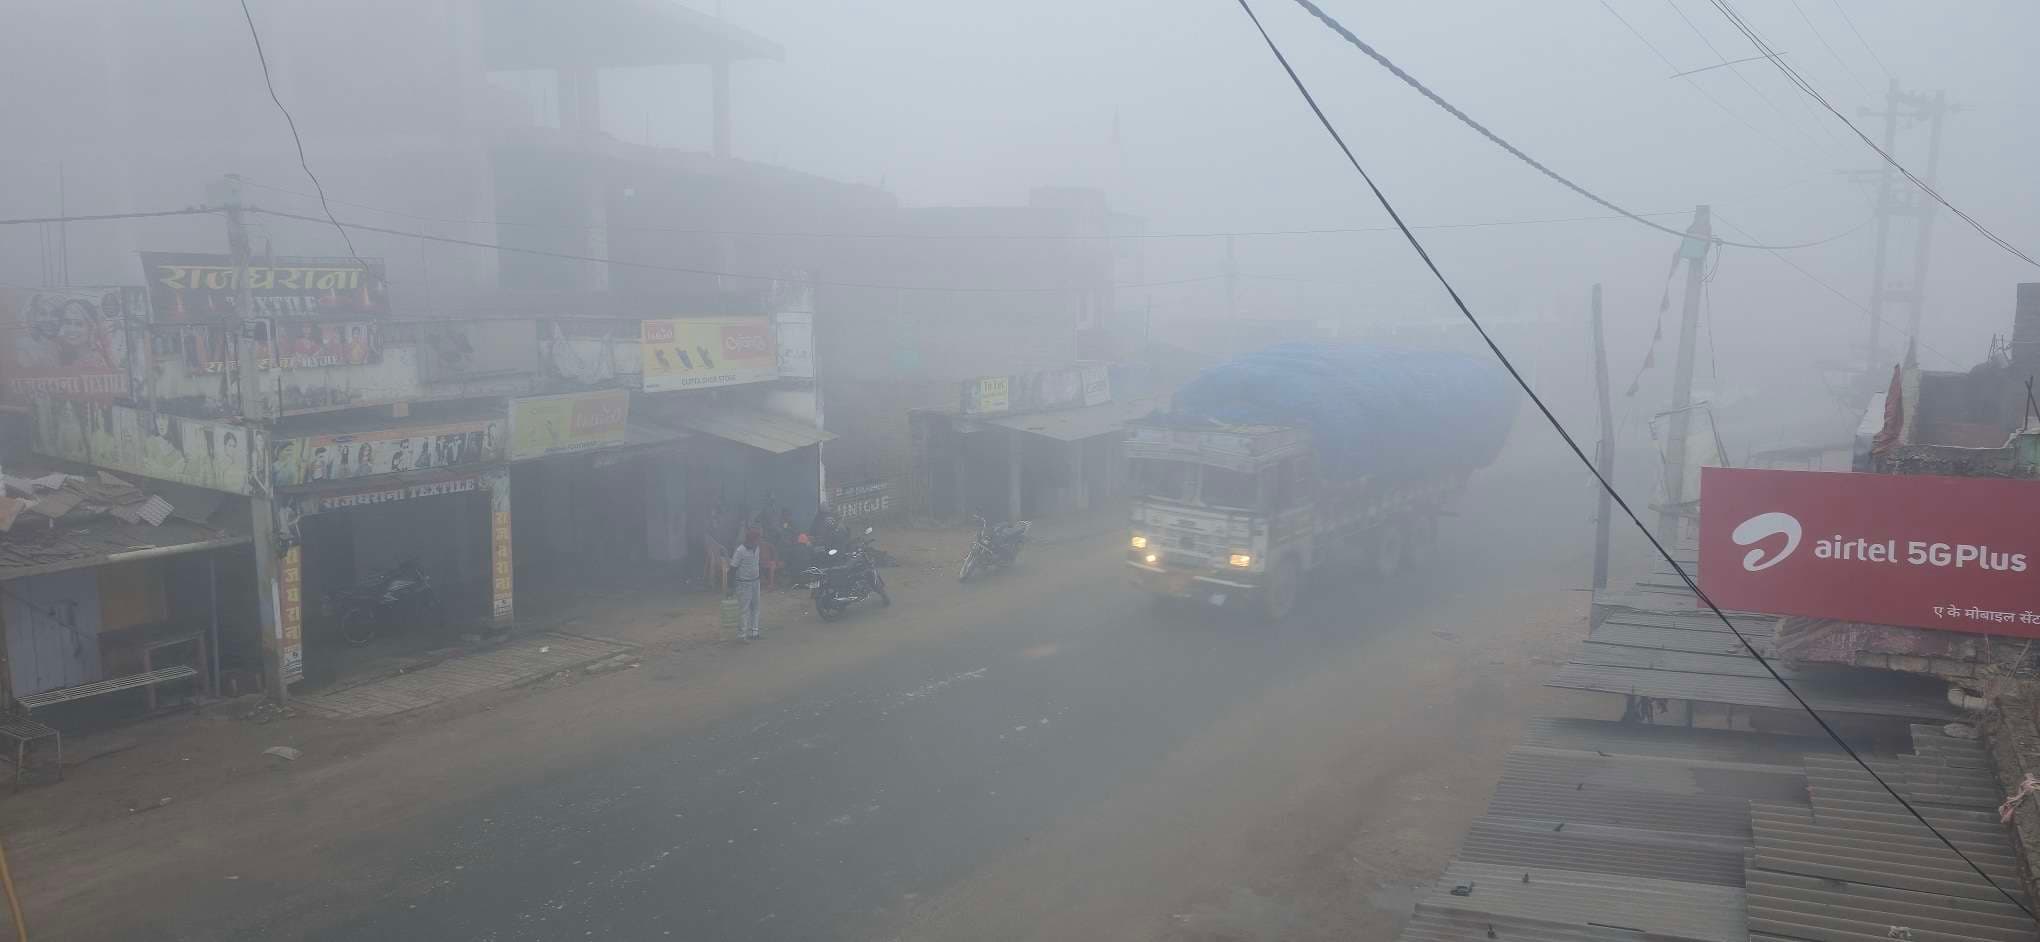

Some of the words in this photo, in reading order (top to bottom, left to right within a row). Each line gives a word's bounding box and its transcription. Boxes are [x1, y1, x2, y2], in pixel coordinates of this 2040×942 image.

[409, 478, 475, 499] TEXTILE
[1813, 534, 1898, 564] airtel
[1933, 605, 1944, 620] ए
[1947, 603, 1961, 620] के
[1964, 606, 2015, 625] मोबाइल
